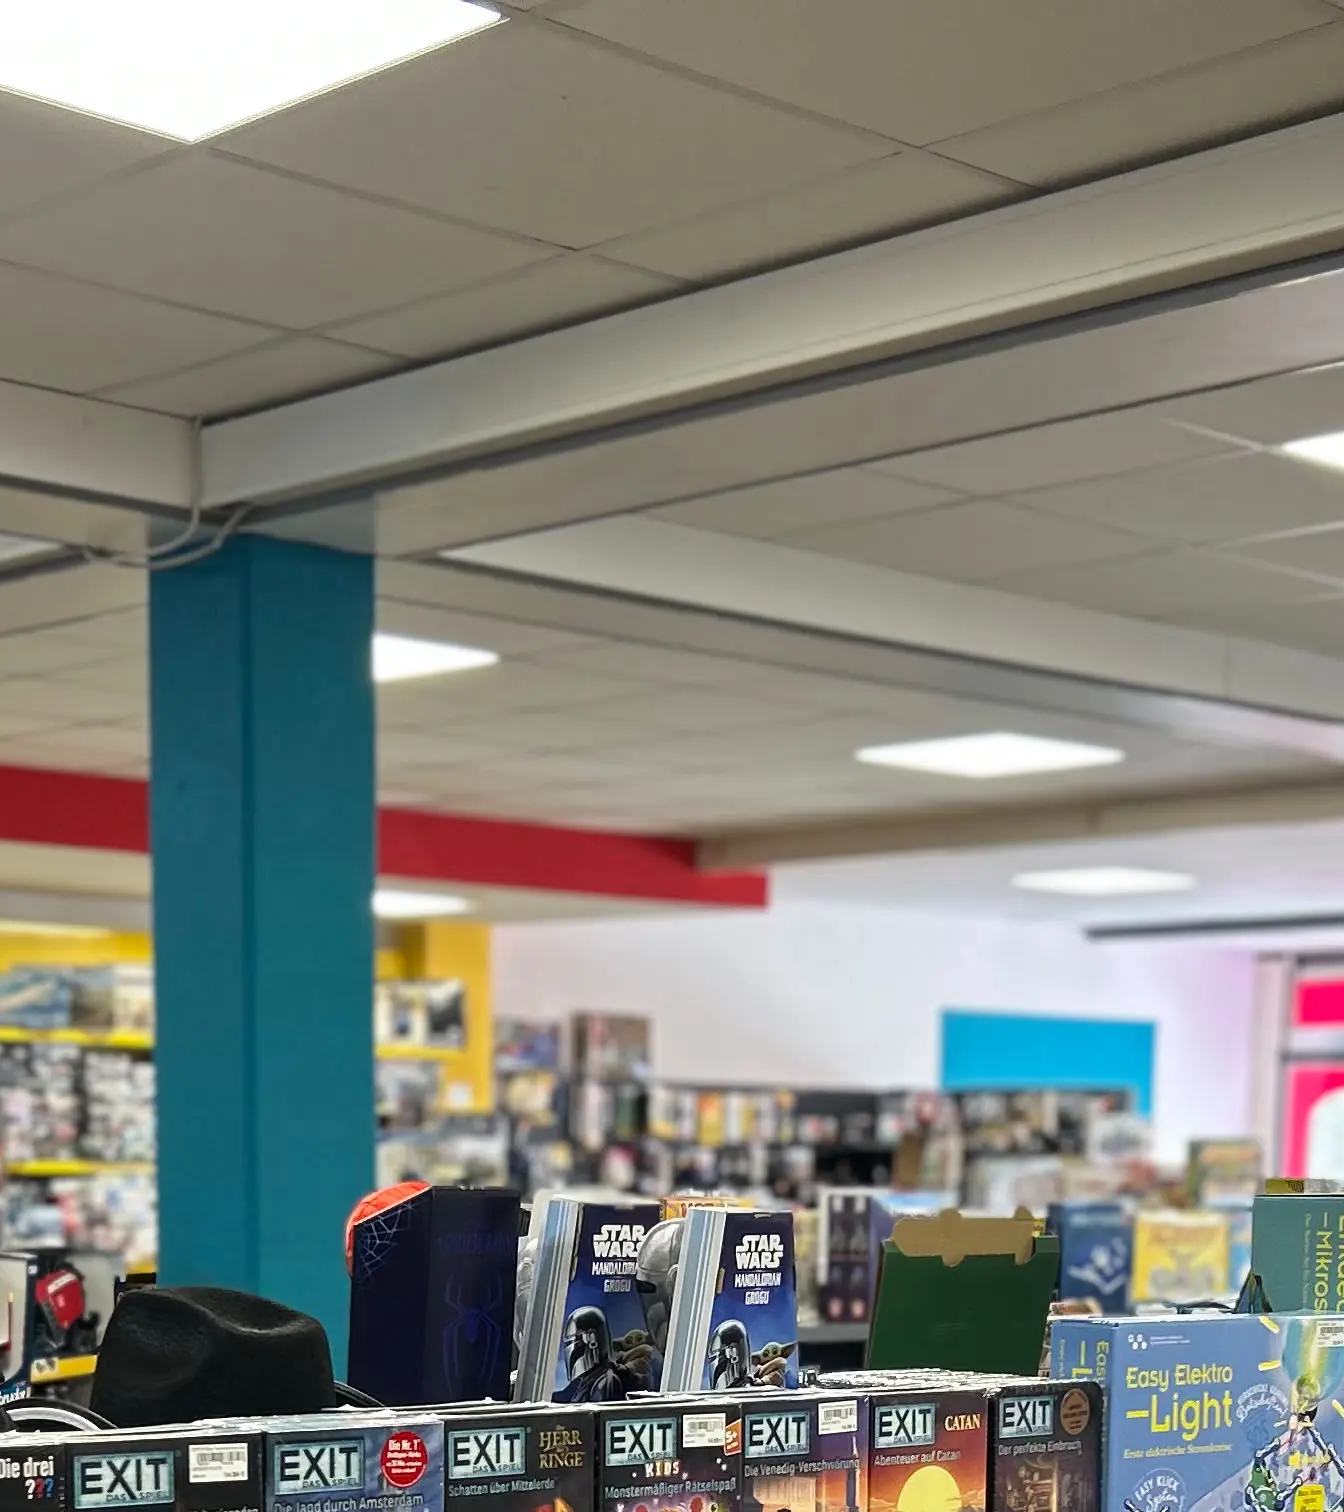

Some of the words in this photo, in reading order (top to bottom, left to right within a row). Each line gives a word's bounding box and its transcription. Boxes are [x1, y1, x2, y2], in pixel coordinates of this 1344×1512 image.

[741, 1234, 783, 1252] STAR
[736, 1251, 783, 1269] WARS
[1127, 1367, 1169, 1392] Easy
[1175, 1364, 1233, 1385] Elektro
[878, 1408, 933, 1446] EXIT
[944, 1413, 981, 1431] CATAN
[453, 1432, 522, 1471] EXIT
[610, 1422, 674, 1460] EXIT
[22, 1456, 55, 1477] drei
[280, 1447, 358, 1487] EXIT
[645, 1461, 679, 1477] KIDS
[323, 1497, 357, 1512] durch
[359, 1494, 424, 1510] Amsterdam
